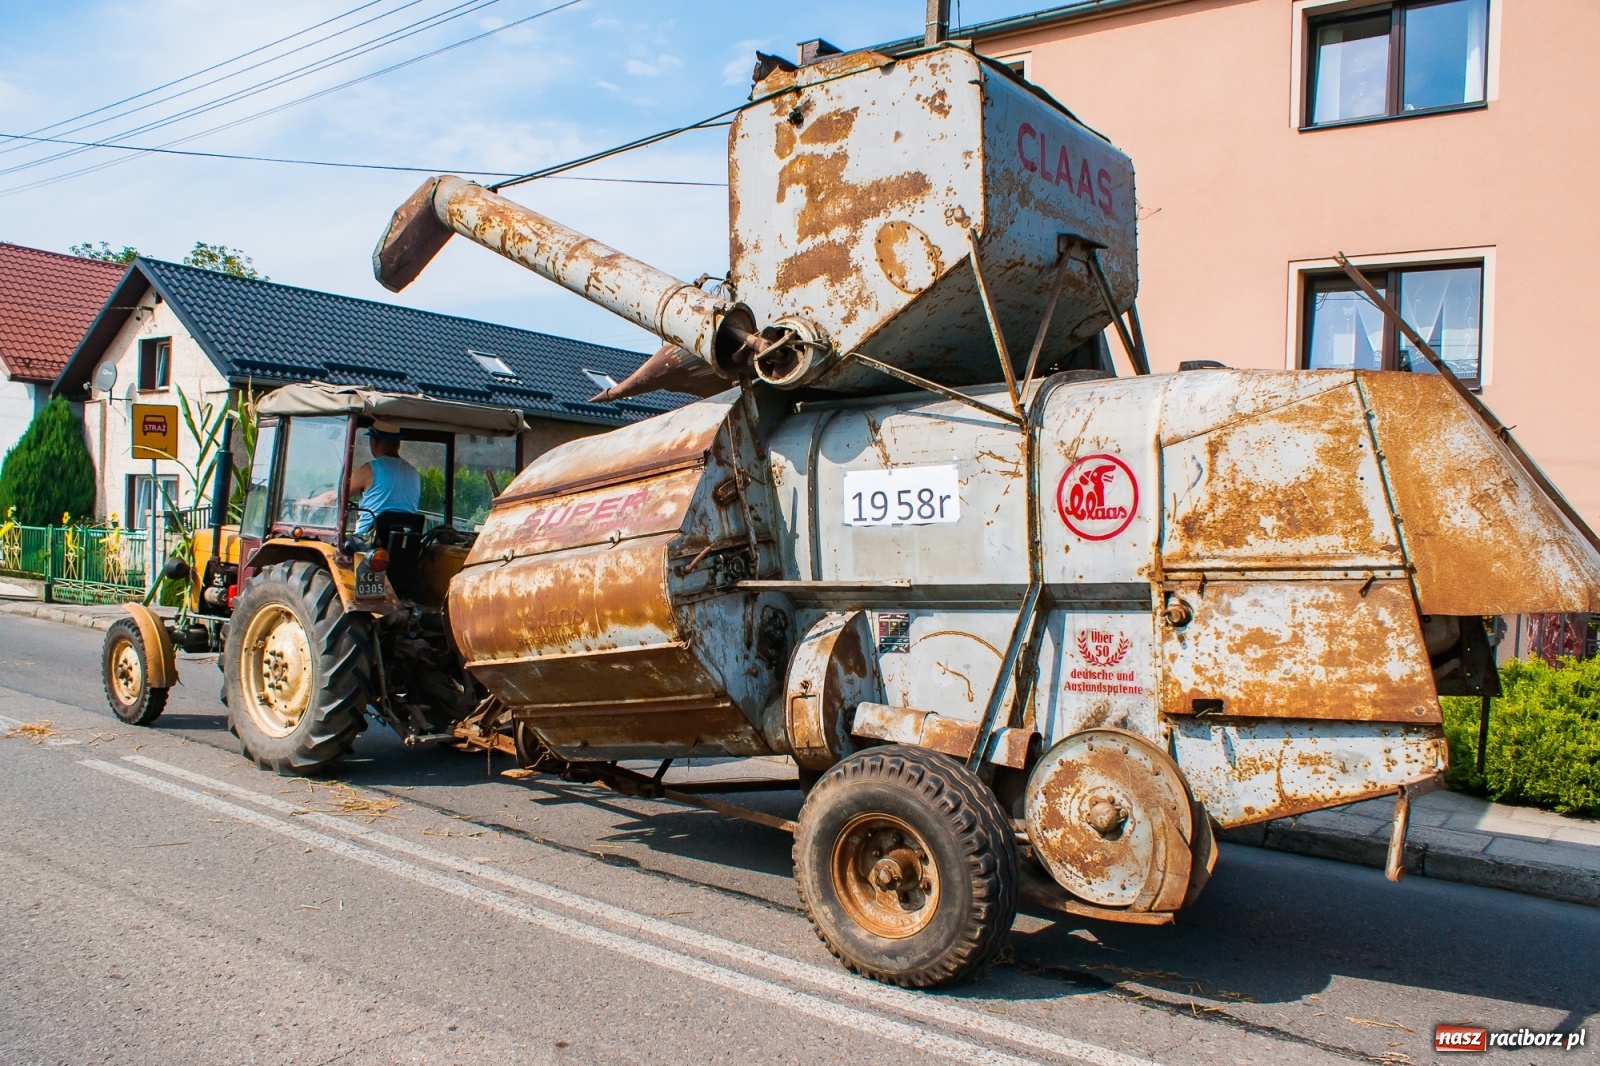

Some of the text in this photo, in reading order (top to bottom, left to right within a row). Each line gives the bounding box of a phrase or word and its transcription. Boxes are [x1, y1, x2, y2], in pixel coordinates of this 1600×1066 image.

[1017, 122, 1113, 214] CLAAS
[144, 424, 166, 432] STRAŻ
[1065, 483, 1128, 521] Claas
[514, 490, 649, 535] SUPER
[358, 584, 384, 594] 0305
[1091, 629, 1114, 643] Über
[1094, 645, 1110, 657] 50
[1070, 668, 1134, 682] deutsche und
[1063, 681, 1143, 696] Auslandspatente
